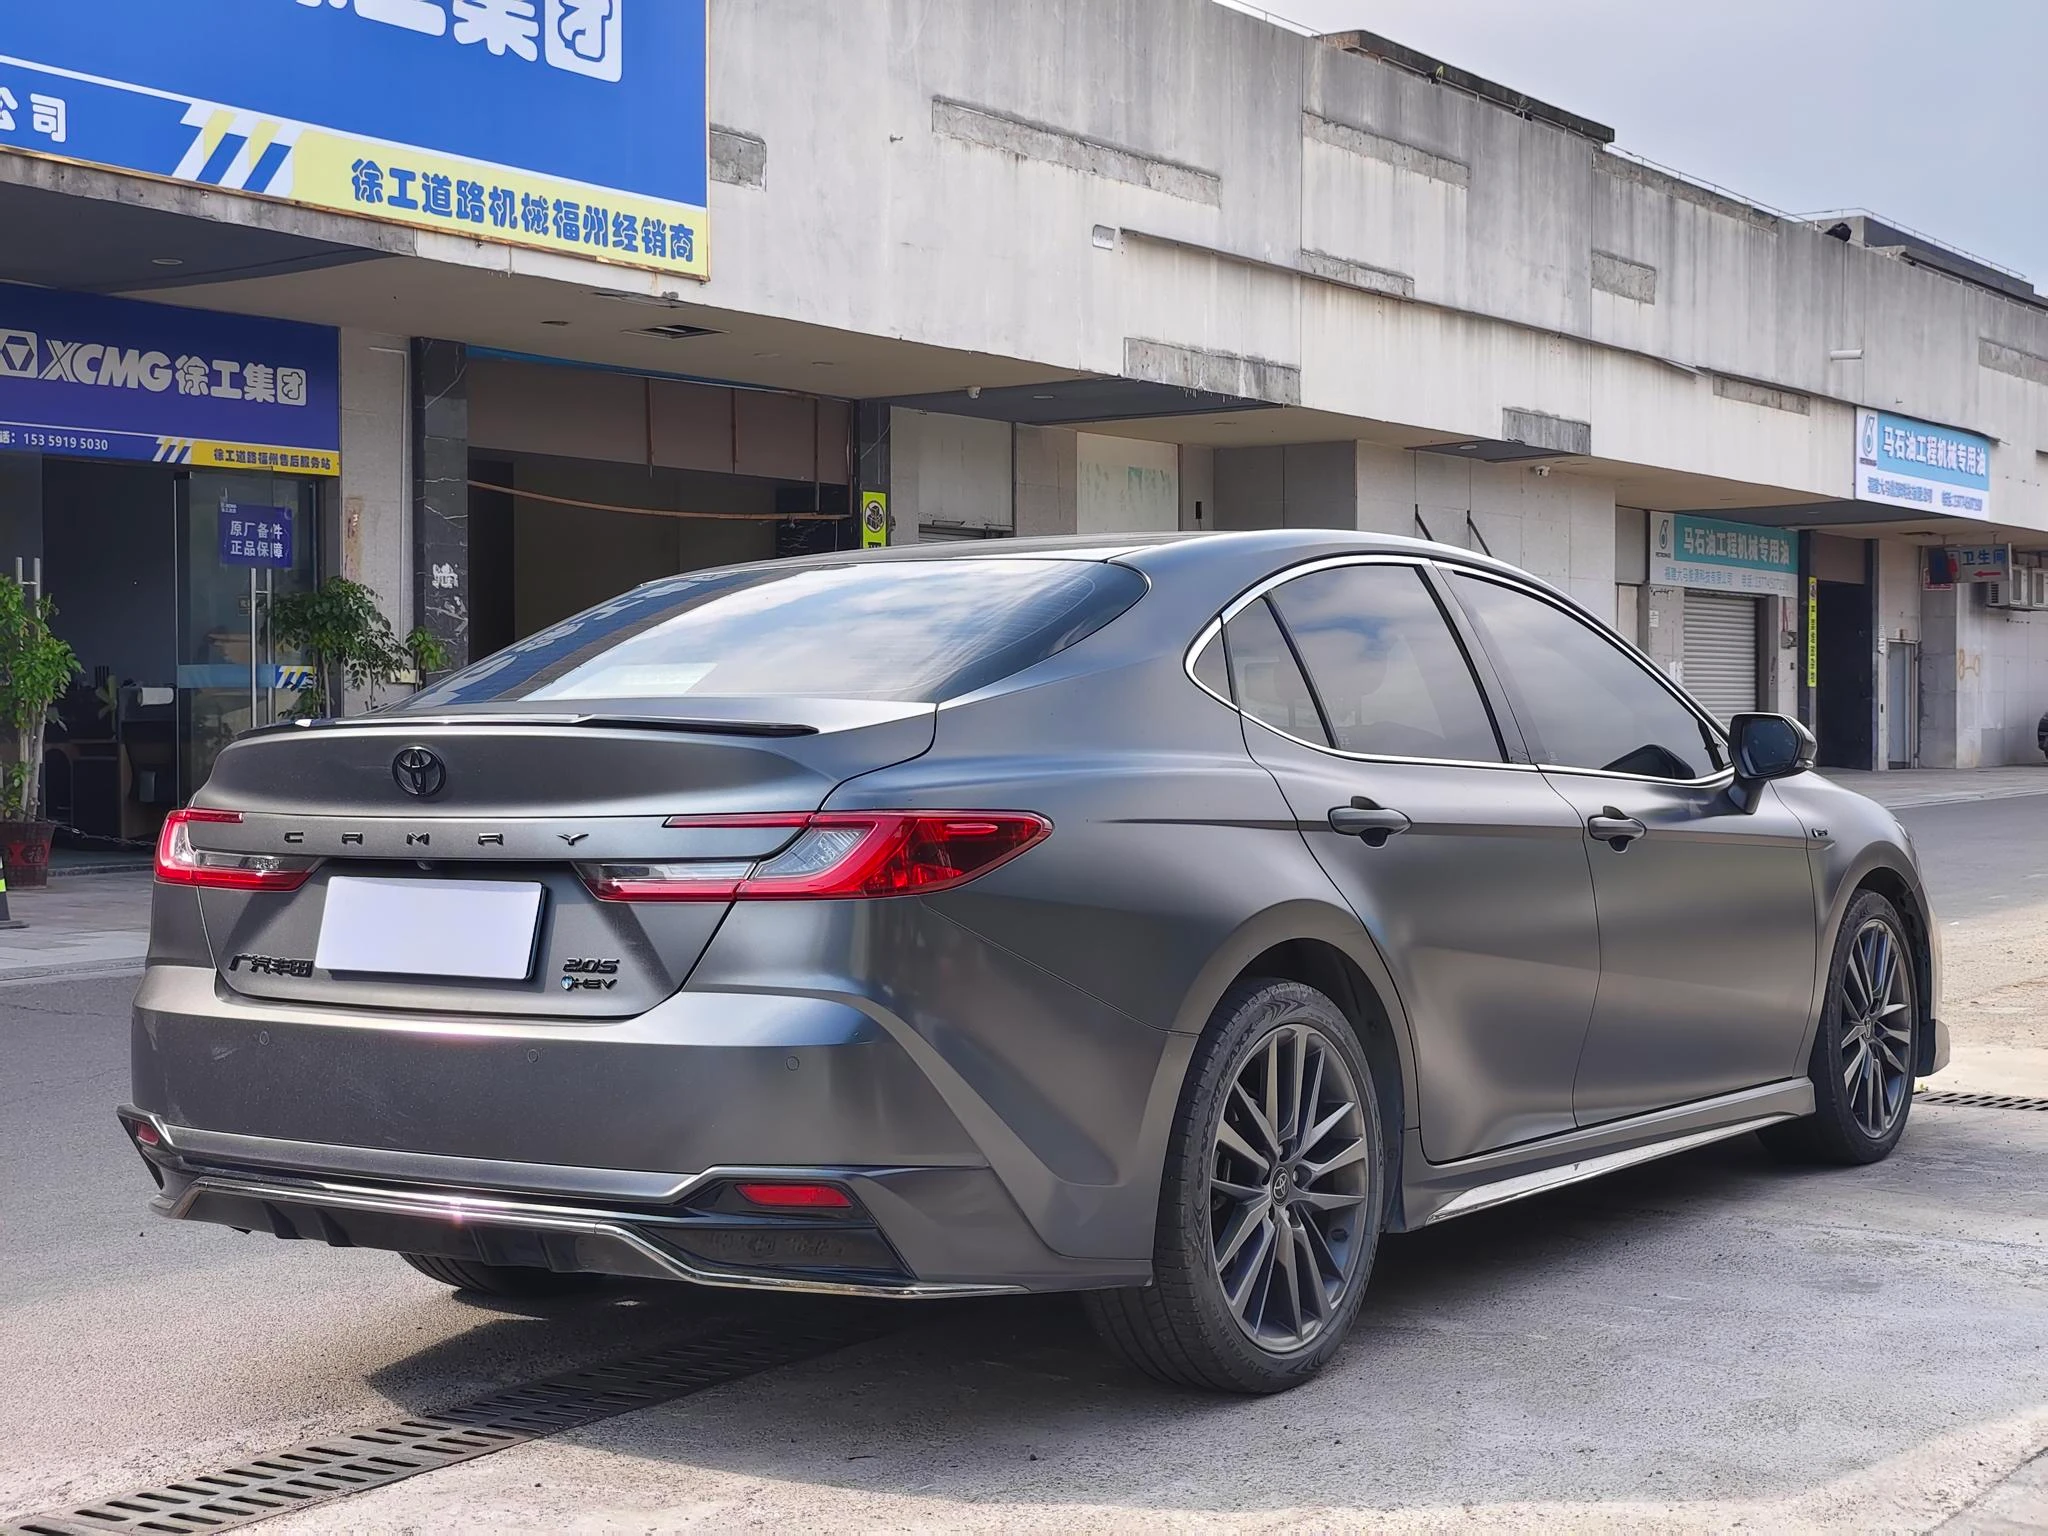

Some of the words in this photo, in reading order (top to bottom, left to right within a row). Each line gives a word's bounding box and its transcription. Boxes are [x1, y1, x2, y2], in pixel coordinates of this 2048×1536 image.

[297, 0, 623, 83] 集团
[351, 157, 694, 263] 徐工道路机械福州经销商
[39, 338, 172, 392] XCMG
[175, 354, 307, 406] 徐工集团
[24, 433, 45, 446] 153
[48, 435, 77, 449] 5919
[80, 438, 109, 451] 5030
[1883, 426, 1986, 477] 马石油工程机械专用油
[213, 448, 331, 470] 徐工道路福州售后服务站
[230, 520, 283, 540] 原厂备件
[230, 540, 283, 559] 正品保障
[1683, 527, 1790, 566] 马石油工程机械专用油
[1962, 549, 2006, 566] 卫生间
[283, 831, 589, 847] CAMRY
